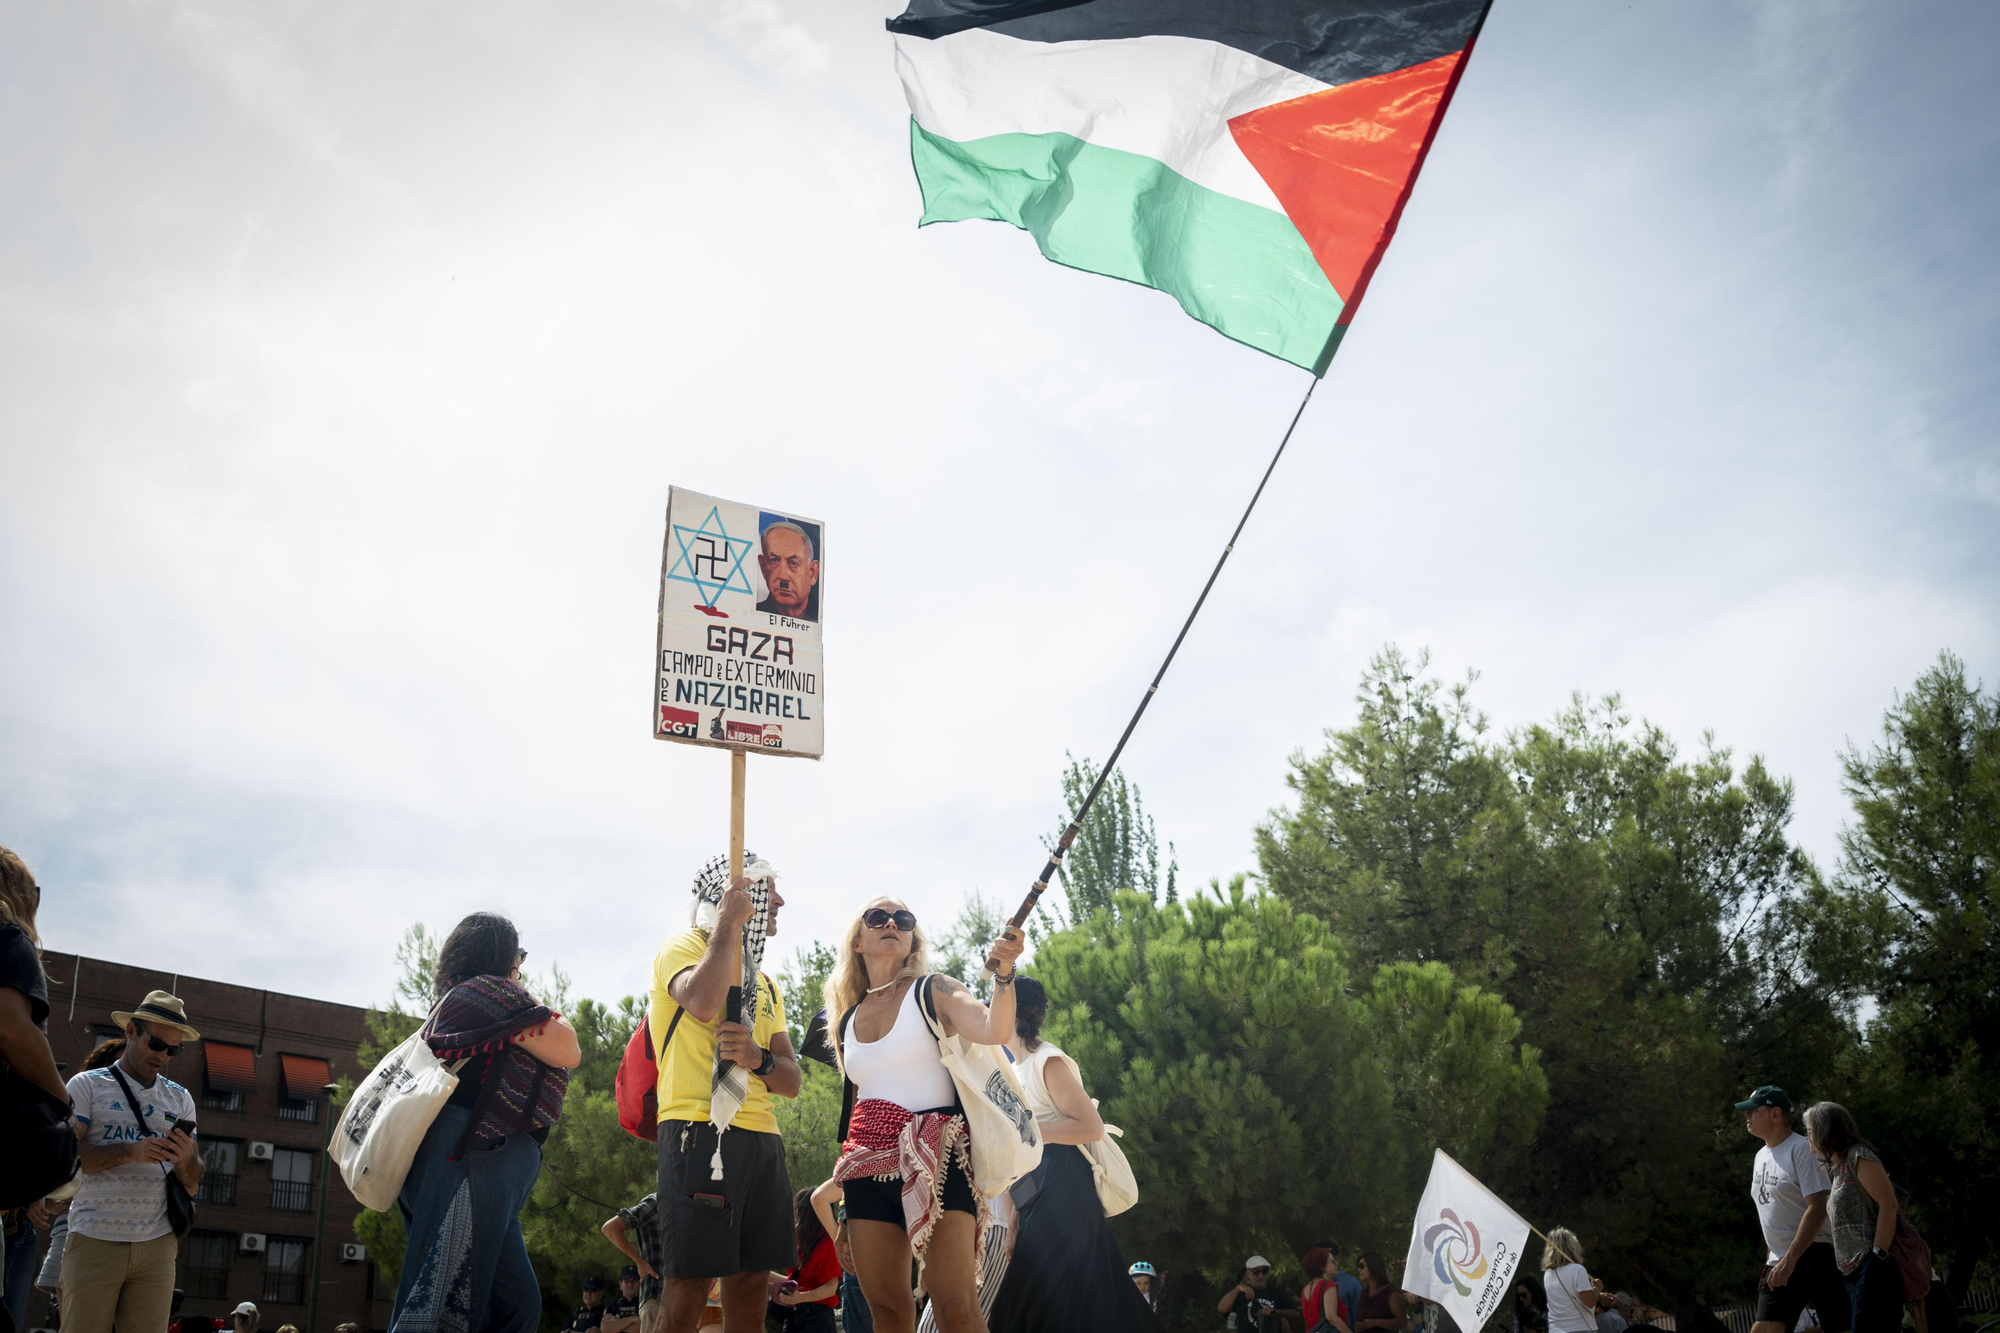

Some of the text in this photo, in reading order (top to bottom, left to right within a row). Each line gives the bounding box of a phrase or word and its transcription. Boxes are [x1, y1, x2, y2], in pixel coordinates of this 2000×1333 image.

[769, 615, 811, 631] El Führer
[707, 624, 794, 665] GAZA
[662, 650, 713, 677] CAMPO
[725, 658, 816, 694] EXTERMINIO
[675, 678, 811, 721] NAZISRAEL
[661, 719, 697, 737] CGT
[727, 724, 760, 735] PALESTINA
[727, 730, 761, 744] LIBRE
[763, 737, 781, 747] CGT
